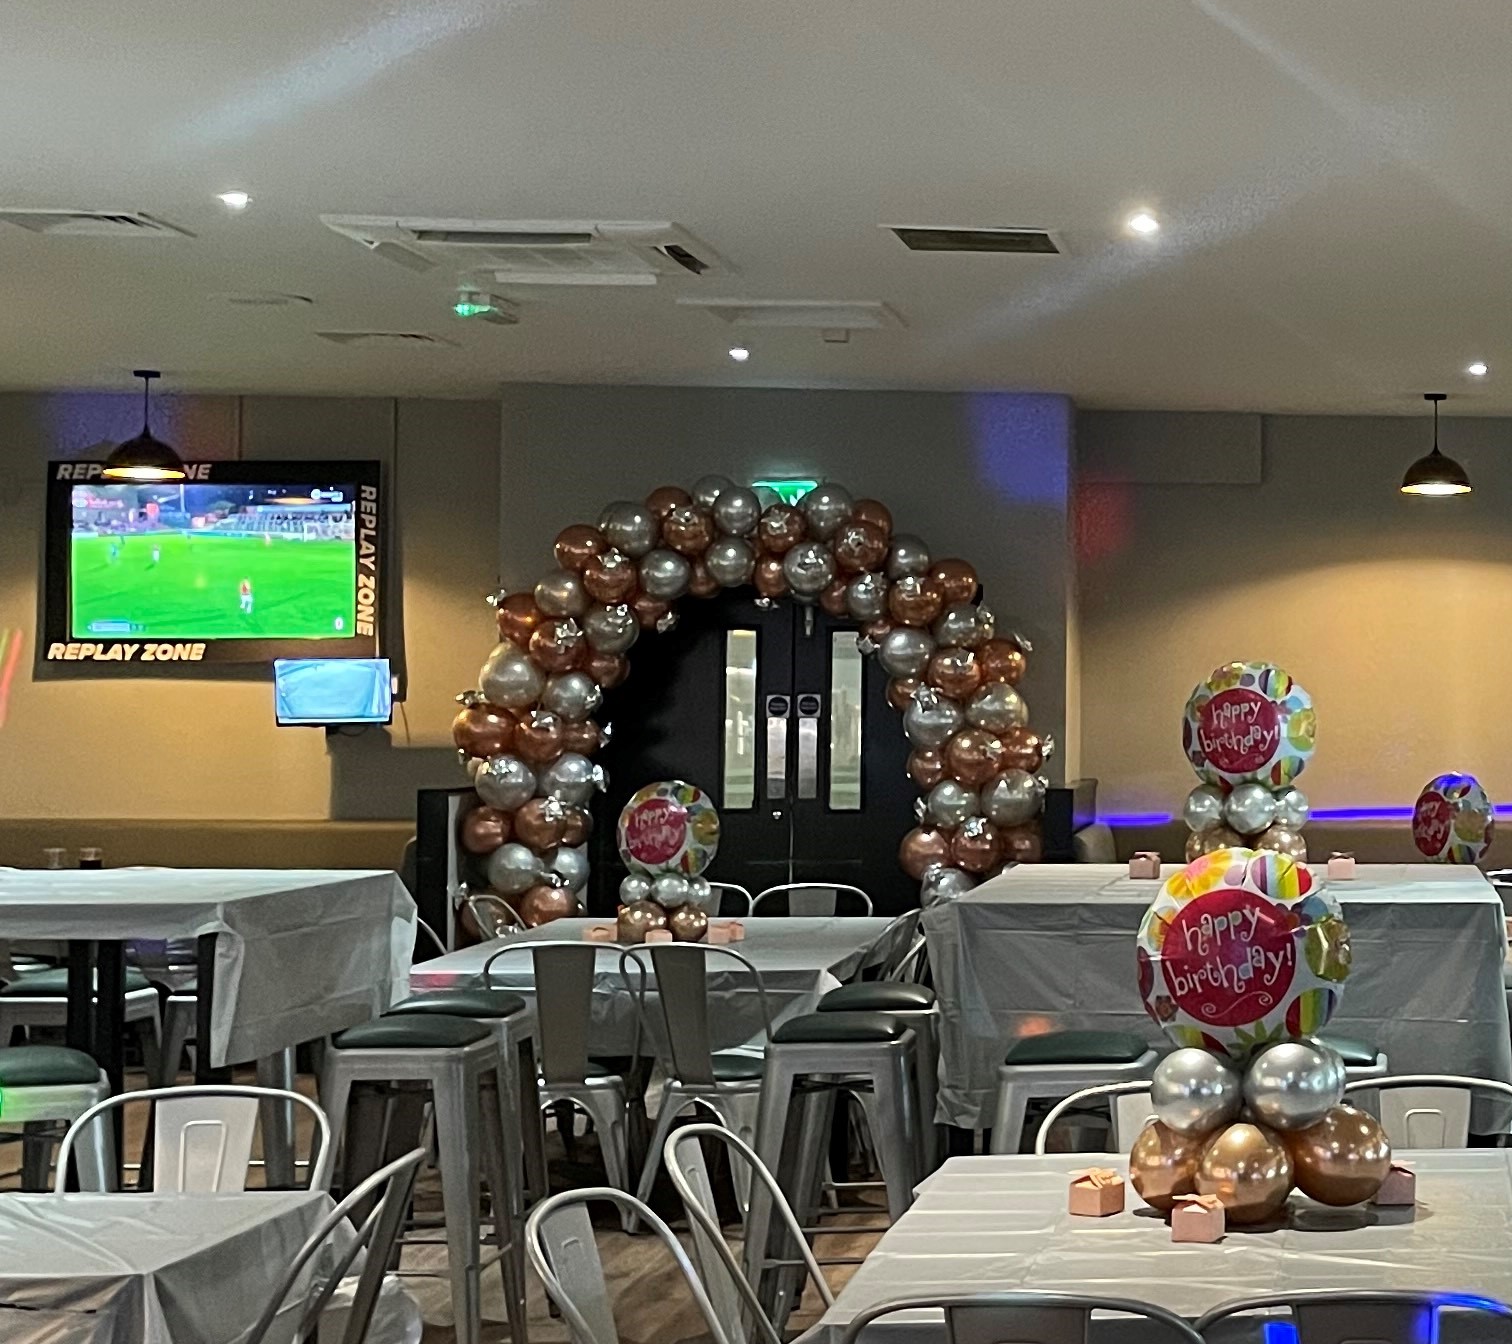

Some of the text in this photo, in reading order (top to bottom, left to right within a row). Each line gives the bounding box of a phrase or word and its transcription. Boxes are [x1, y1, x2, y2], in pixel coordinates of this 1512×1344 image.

[56, 463, 106, 481] REP
[356, 484, 377, 637] REPLAY ZONE
[47, 642, 206, 661] REPLAY ZONE
[1211, 701, 1262, 730] happy
[1199, 724, 1279, 755] birthday!
[1181, 903, 1263, 956] happy
[1164, 943, 1293, 998] birthday!
